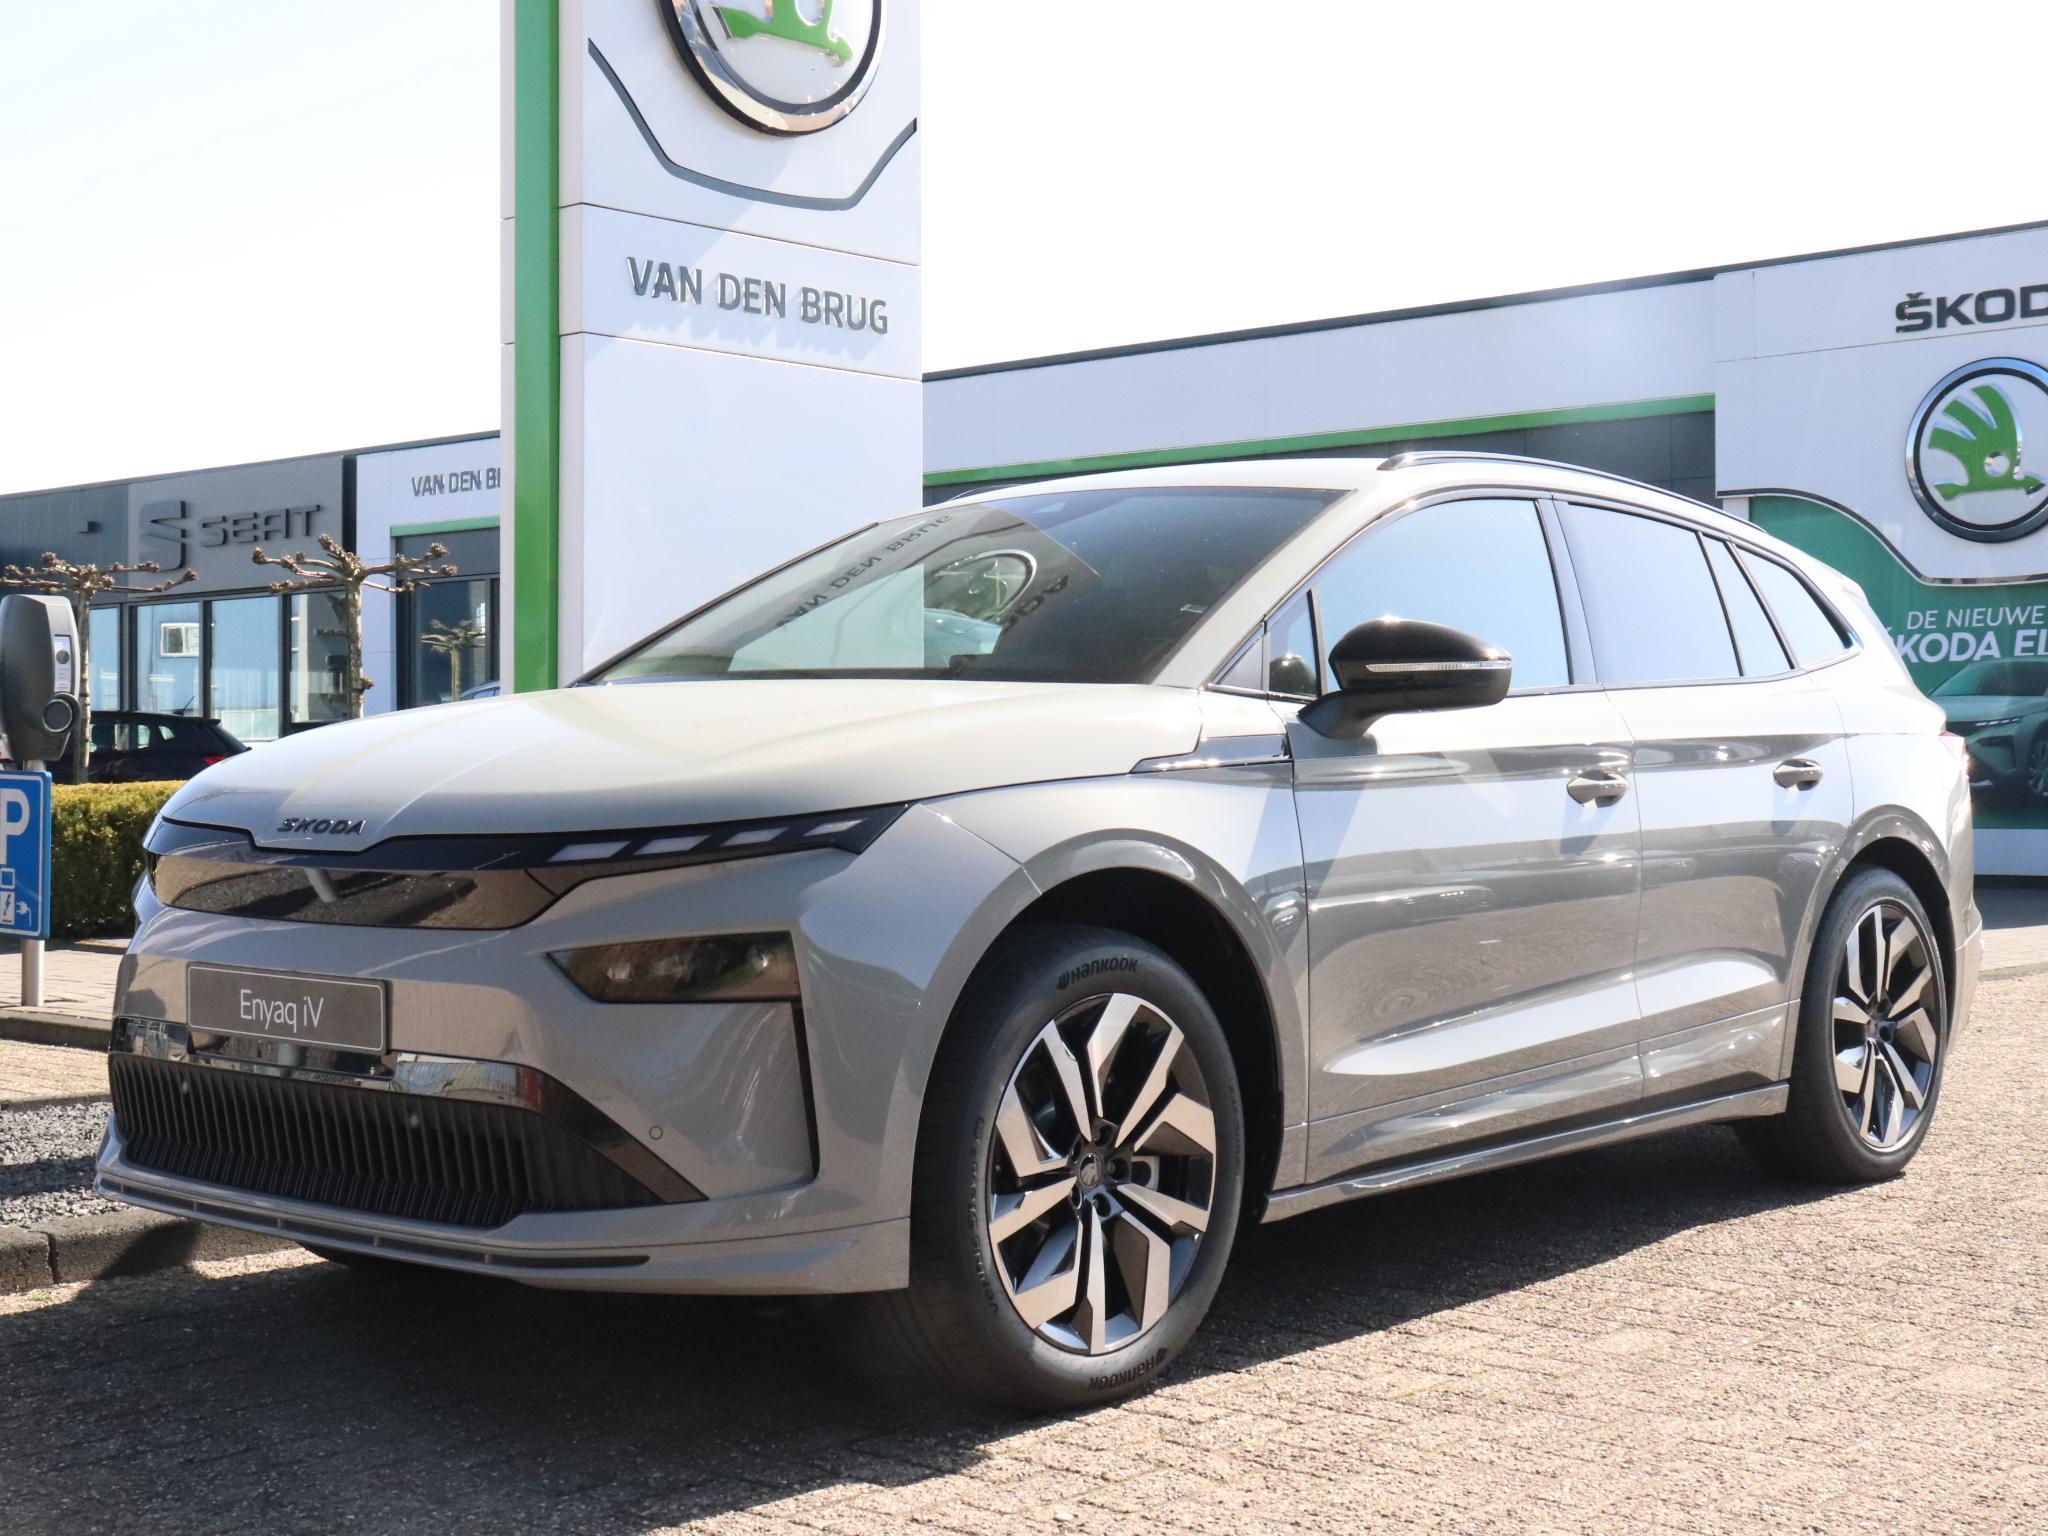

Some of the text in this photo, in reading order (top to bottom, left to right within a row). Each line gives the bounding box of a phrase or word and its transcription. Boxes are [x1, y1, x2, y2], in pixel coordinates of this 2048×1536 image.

[626, 256, 888, 335] VAN DEN BRUG
[411, 474, 445, 497] VAN
[448, 470, 482, 494] DEN
[201, 503, 321, 548] SEAT
[1907, 605, 2046, 630] DE NIEUWE
[1886, 626, 2002, 663] KODA
[0, 788, 30, 865] P
[240, 989, 323, 1033] Enyaq iV
